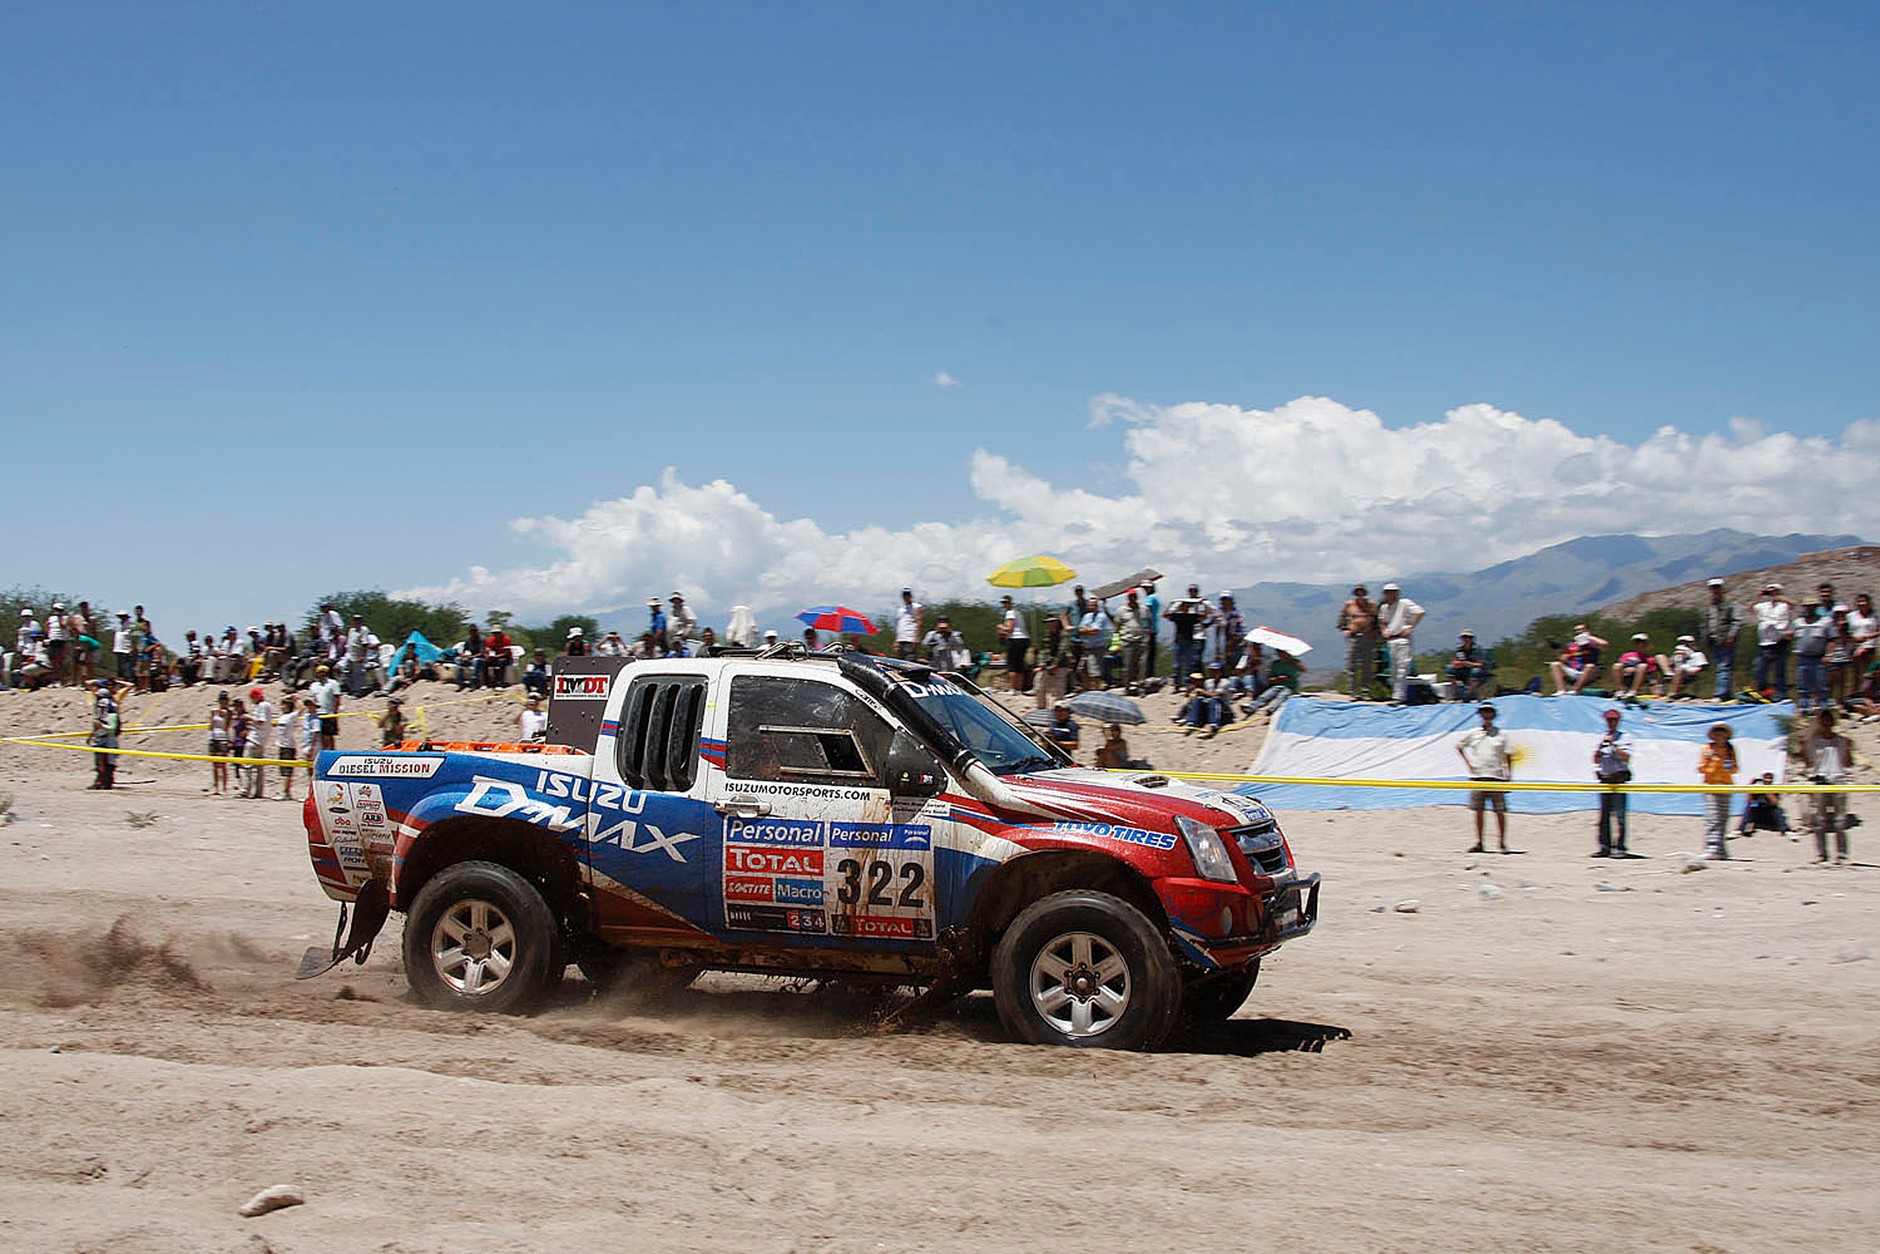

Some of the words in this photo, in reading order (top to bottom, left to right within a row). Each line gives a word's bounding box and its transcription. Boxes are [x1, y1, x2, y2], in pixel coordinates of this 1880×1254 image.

[339, 764, 375, 774] DIESEL
[379, 764, 430, 773] MISSION
[535, 771, 647, 815] ISUZU
[724, 782, 871, 801] ISUZUMOTORSPORTS.COM
[729, 817, 821, 843] Personal
[831, 828, 893, 842] Personal
[1113, 826, 1177, 849] TIRES
[729, 848, 820, 873] TOTAL
[728, 882, 771, 895] LOCTITE
[777, 884, 822, 899] Macro
[837, 859, 925, 908] 322
[855, 918, 912, 934] TOTAL
